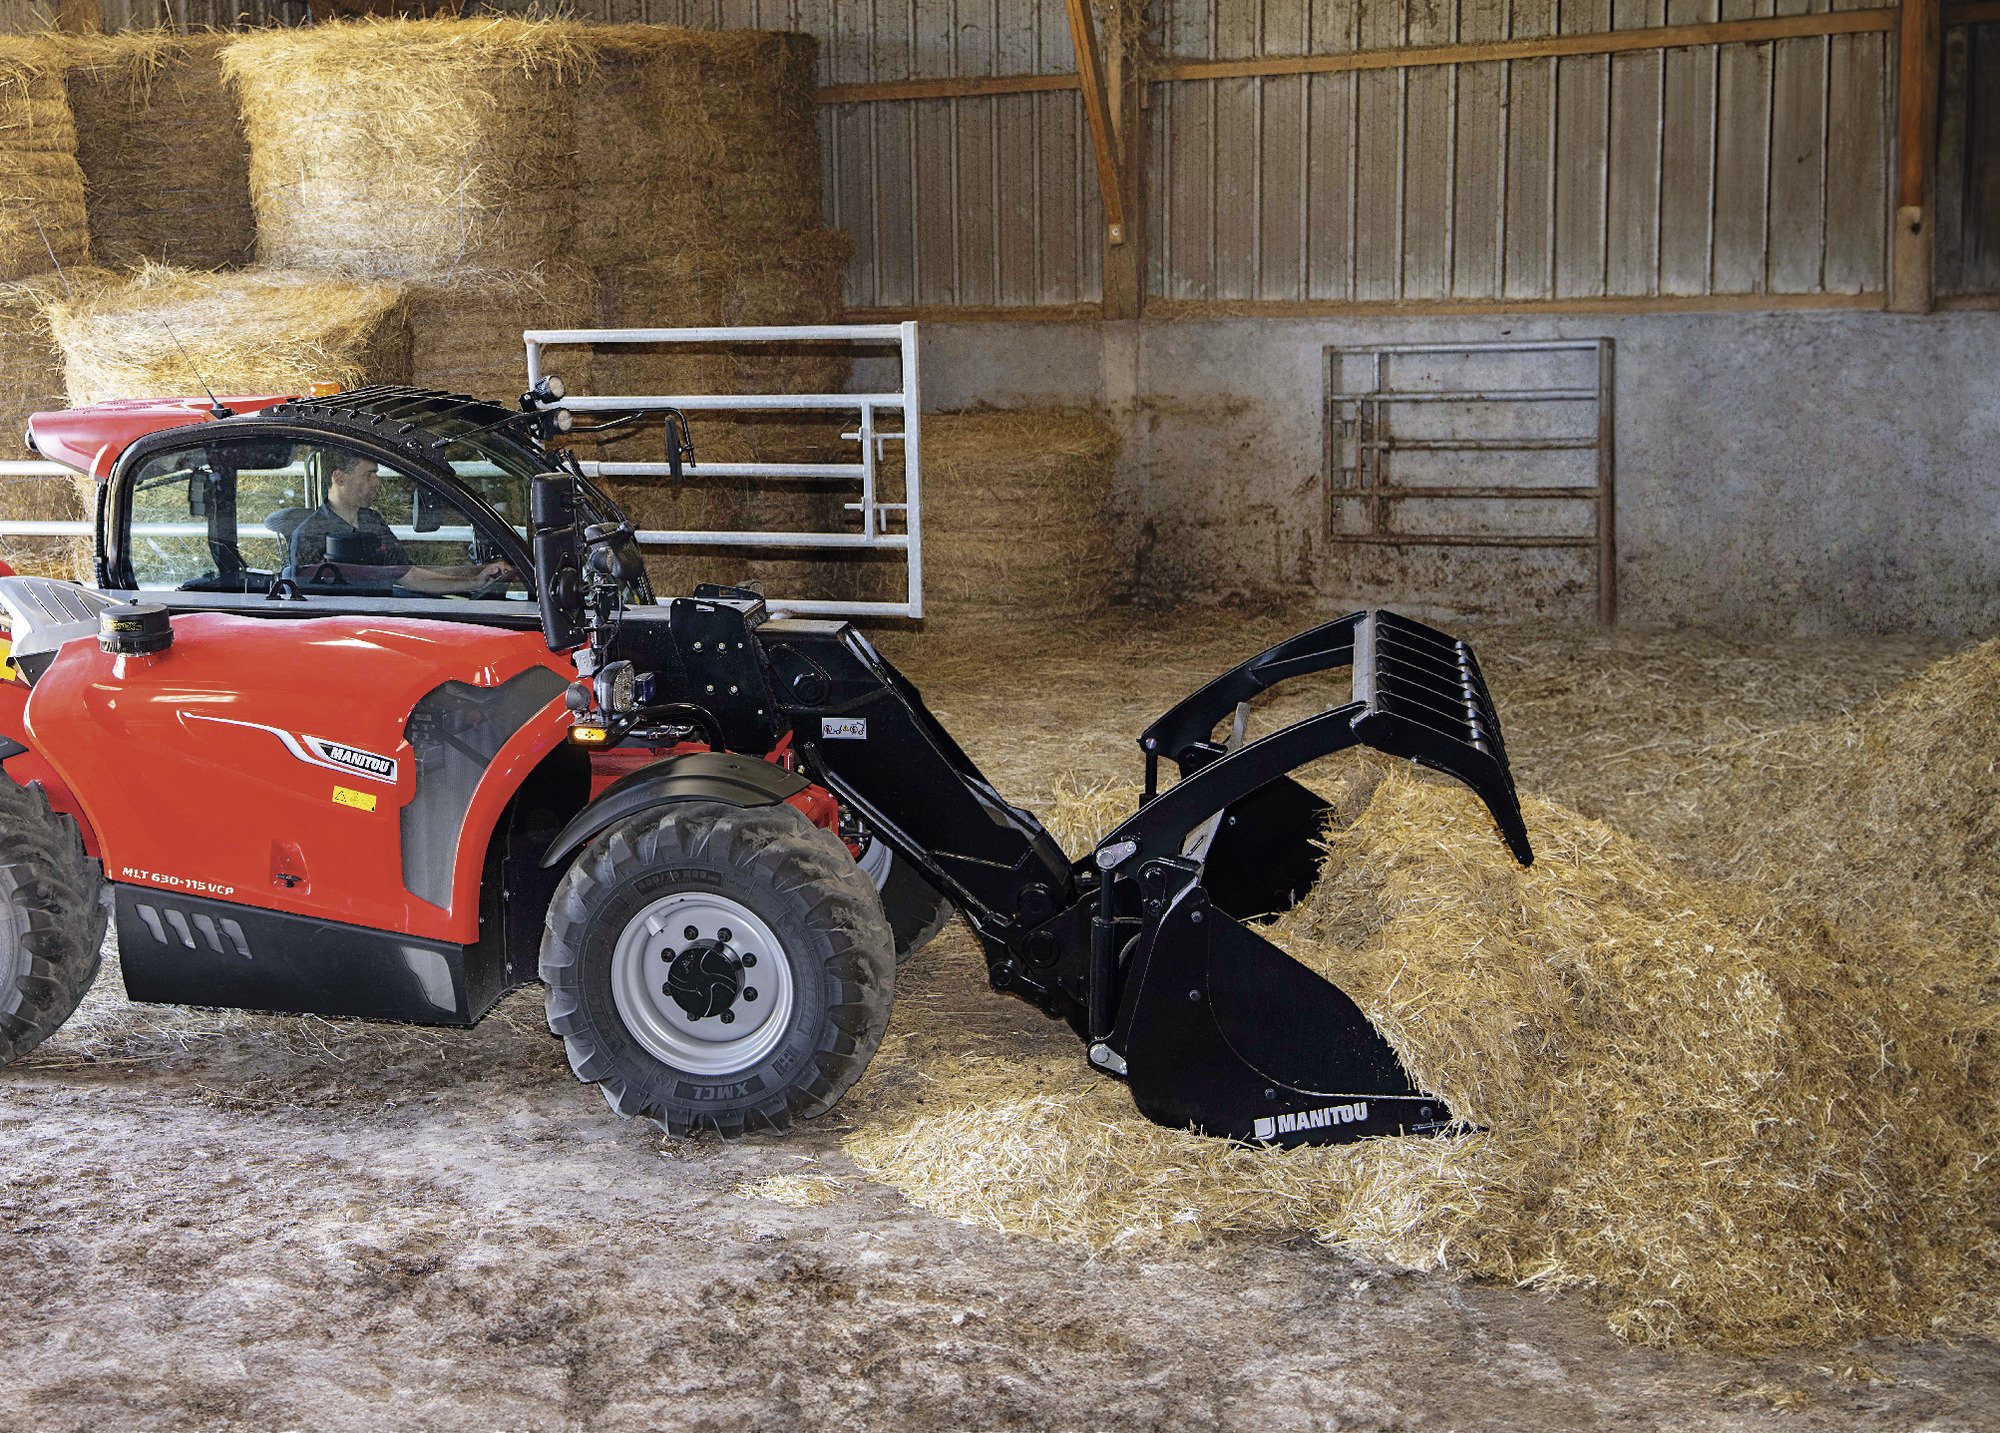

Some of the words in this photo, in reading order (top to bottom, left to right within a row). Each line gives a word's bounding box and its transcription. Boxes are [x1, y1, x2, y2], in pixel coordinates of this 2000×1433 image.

[330, 747, 389, 773] MANITOU
[122, 867, 149, 879] MLT
[692, 1081, 749, 1101] XMCL
[1277, 1102, 1368, 1134] MANITOU
